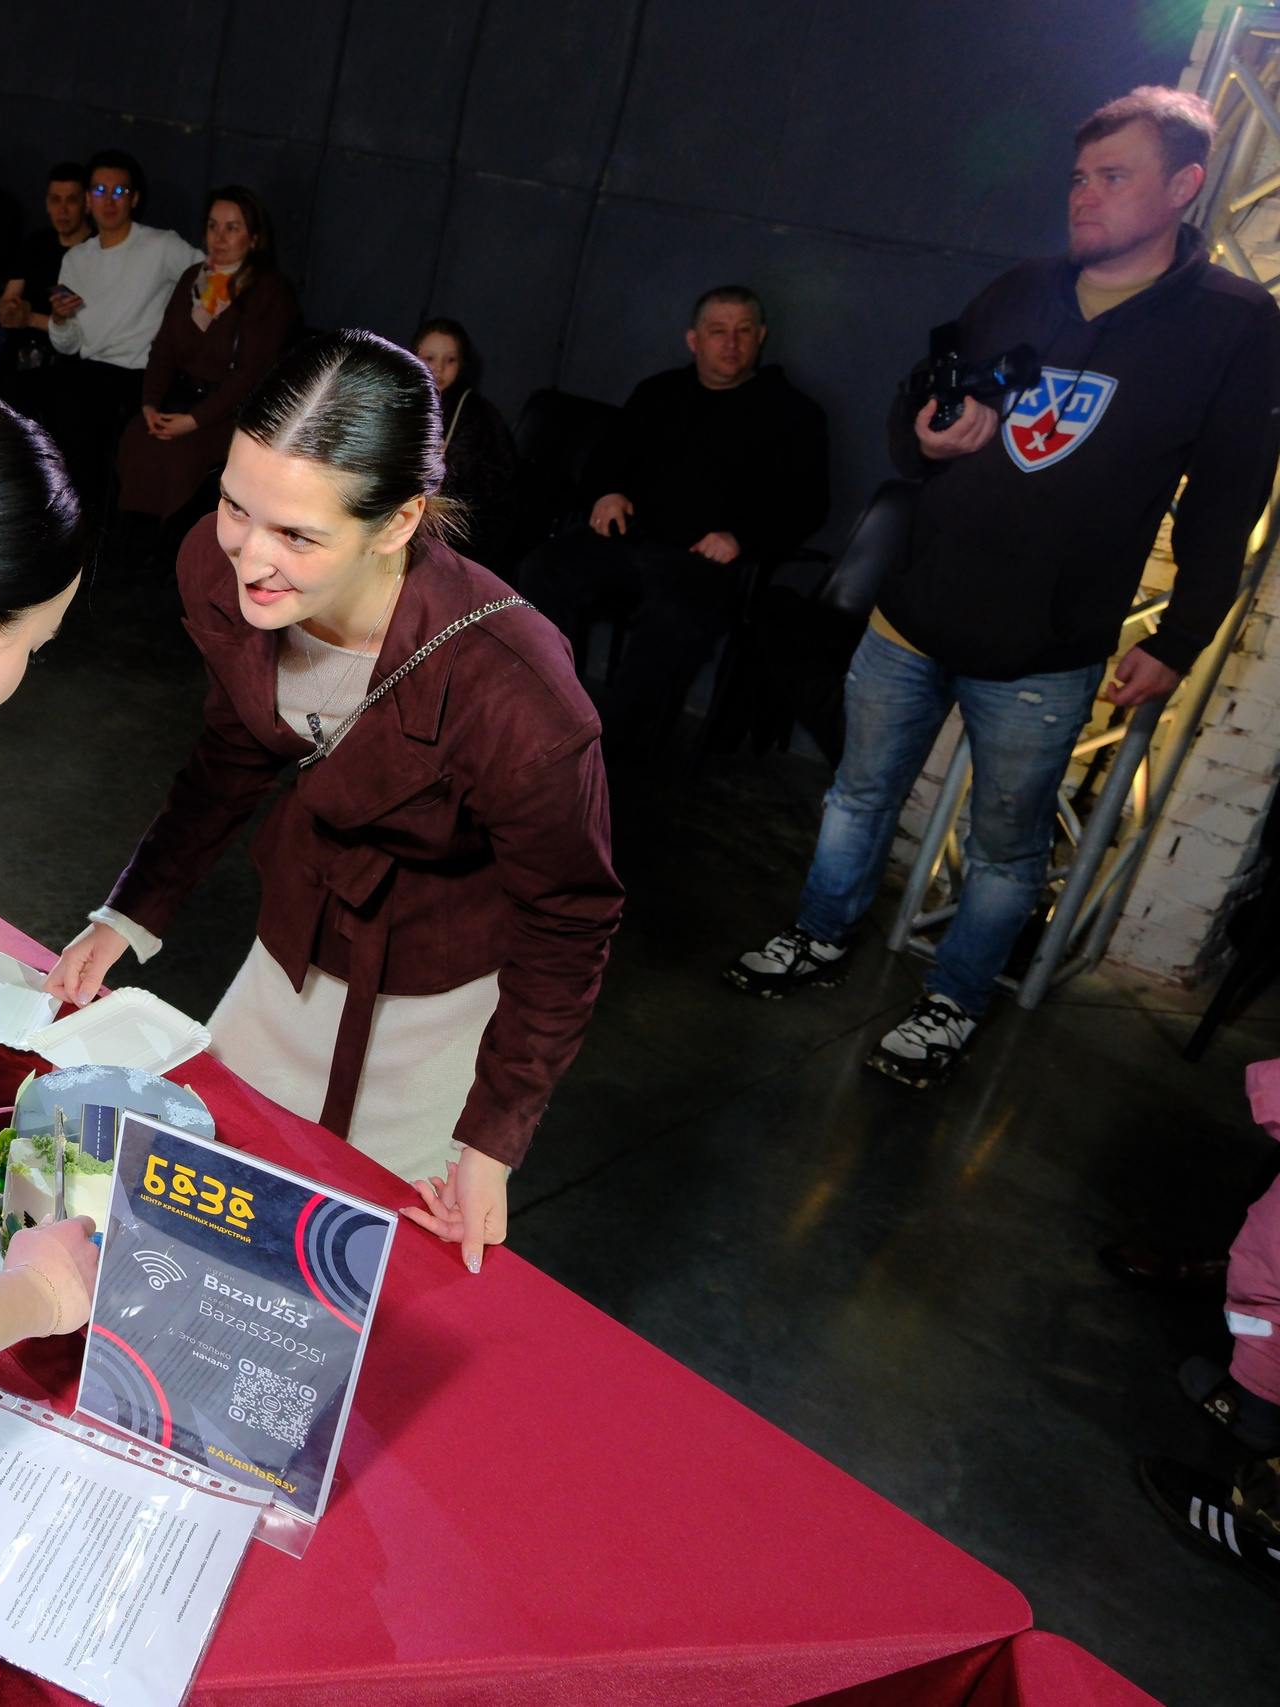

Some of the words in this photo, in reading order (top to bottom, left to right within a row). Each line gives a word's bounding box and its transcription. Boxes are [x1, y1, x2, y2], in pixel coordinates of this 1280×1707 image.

[140, 1193, 163, 1206] ЦЕНТР
[162, 1203, 208, 1226] КРЕАТИВНЫХ
[208, 1222, 252, 1244] ИНДУСТРИЙ
[206, 1266, 235, 1282] ЛОГИН
[203, 1273, 309, 1329] BazaUz53
[179, 1332, 196, 1345] Это
[198, 1341, 232, 1360] только
[199, 1300, 327, 1366] Baza532025!
[192, 1350, 230, 1371] начало
[207, 1445, 297, 1494] #АйдаНаБазу
